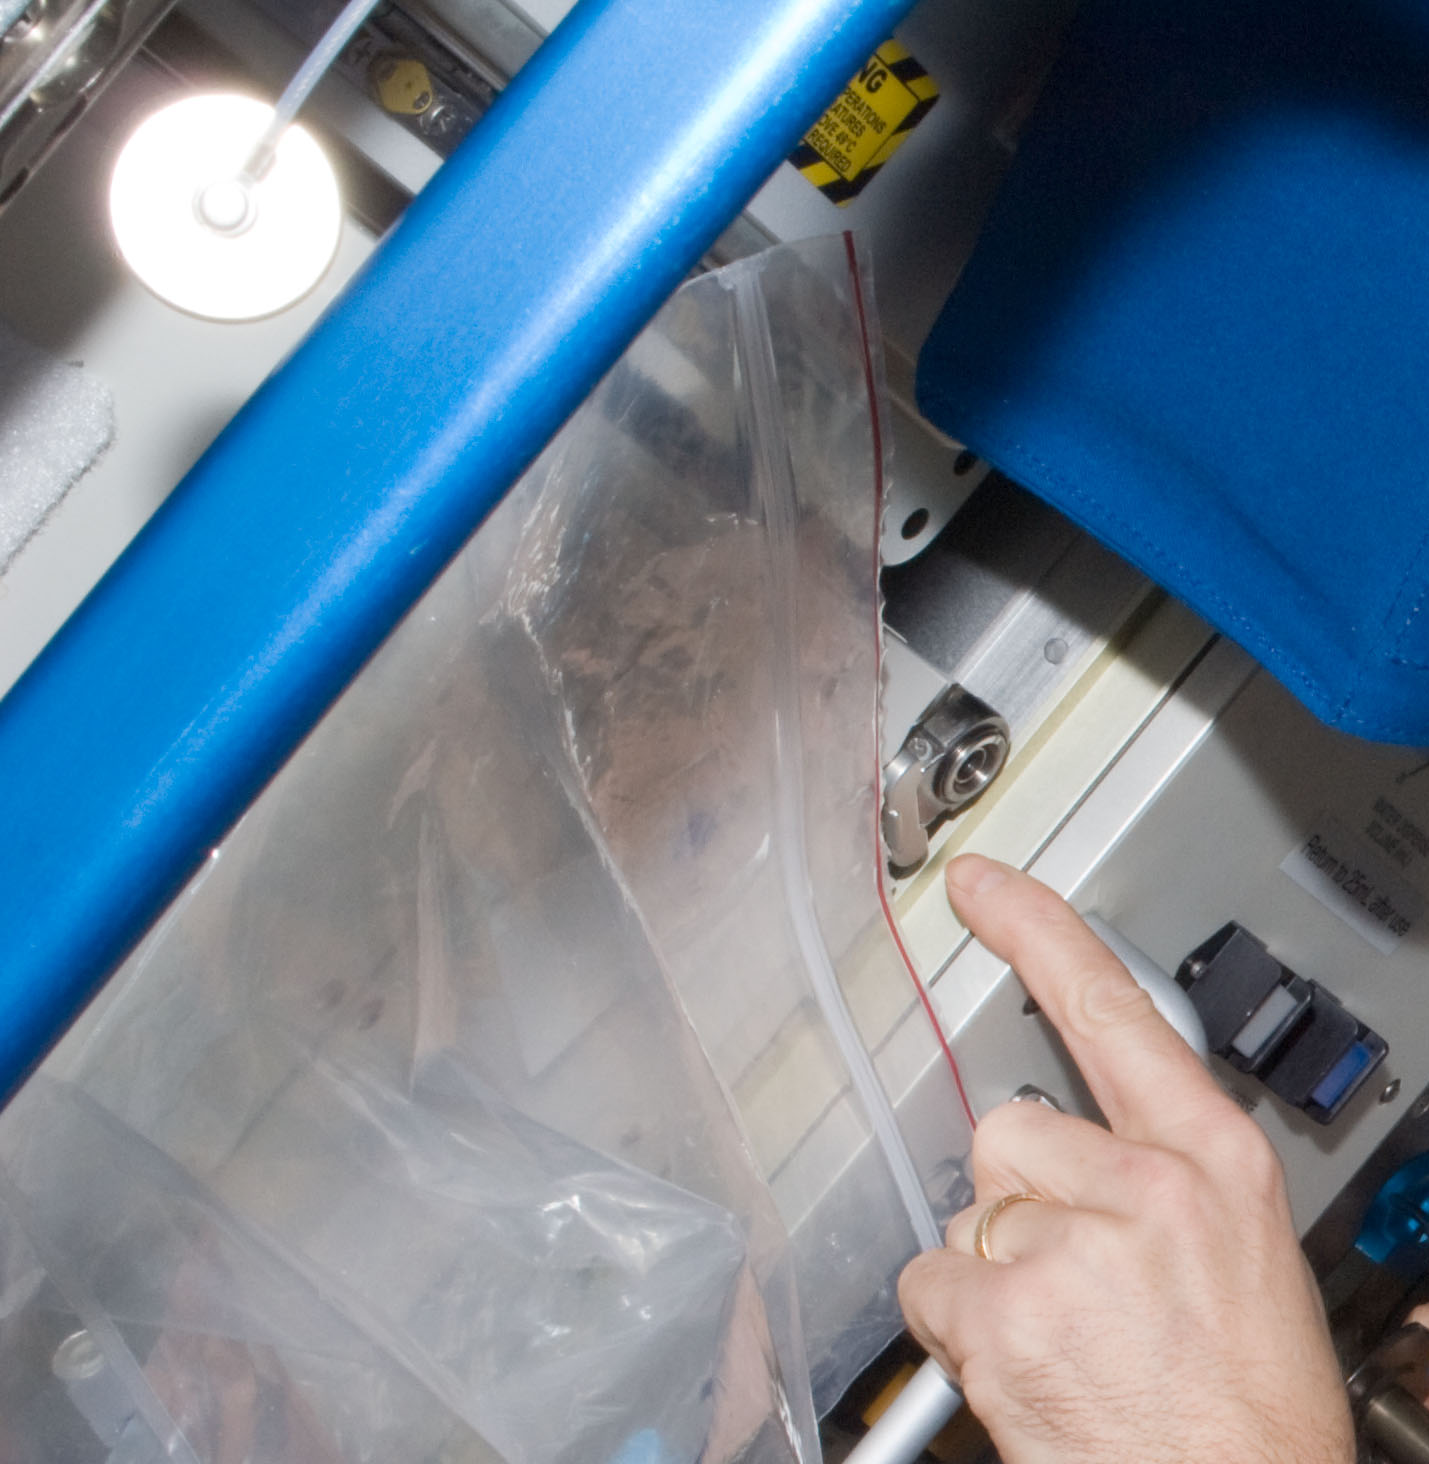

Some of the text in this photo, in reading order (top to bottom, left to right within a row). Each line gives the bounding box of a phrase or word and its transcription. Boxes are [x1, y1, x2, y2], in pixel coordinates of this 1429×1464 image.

[829, 100, 866, 138] ATURES
[1299, 832, 1344, 876] Return
[1330, 863, 1351, 885] to
[1366, 890, 1398, 923] after
[1386, 911, 1413, 938] use
